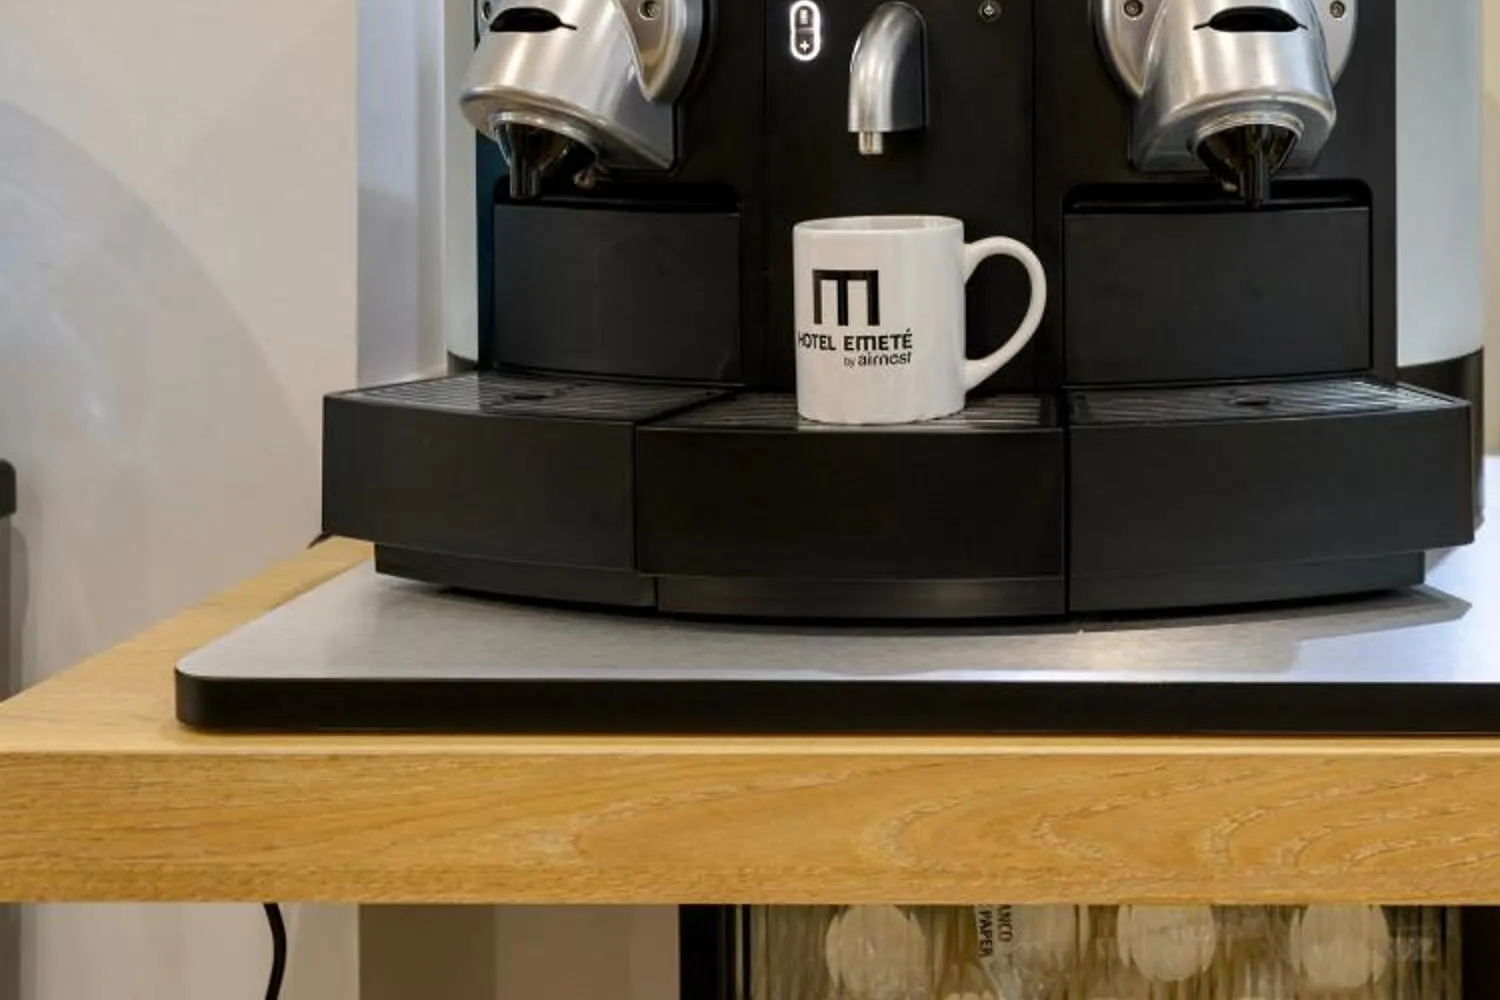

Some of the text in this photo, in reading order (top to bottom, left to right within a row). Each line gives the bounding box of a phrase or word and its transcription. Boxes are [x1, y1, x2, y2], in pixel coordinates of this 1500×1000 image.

[798, 331, 837, 351] HOTEL
[844, 356, 855, 368] by
[978, 911, 993, 957] PAPER
